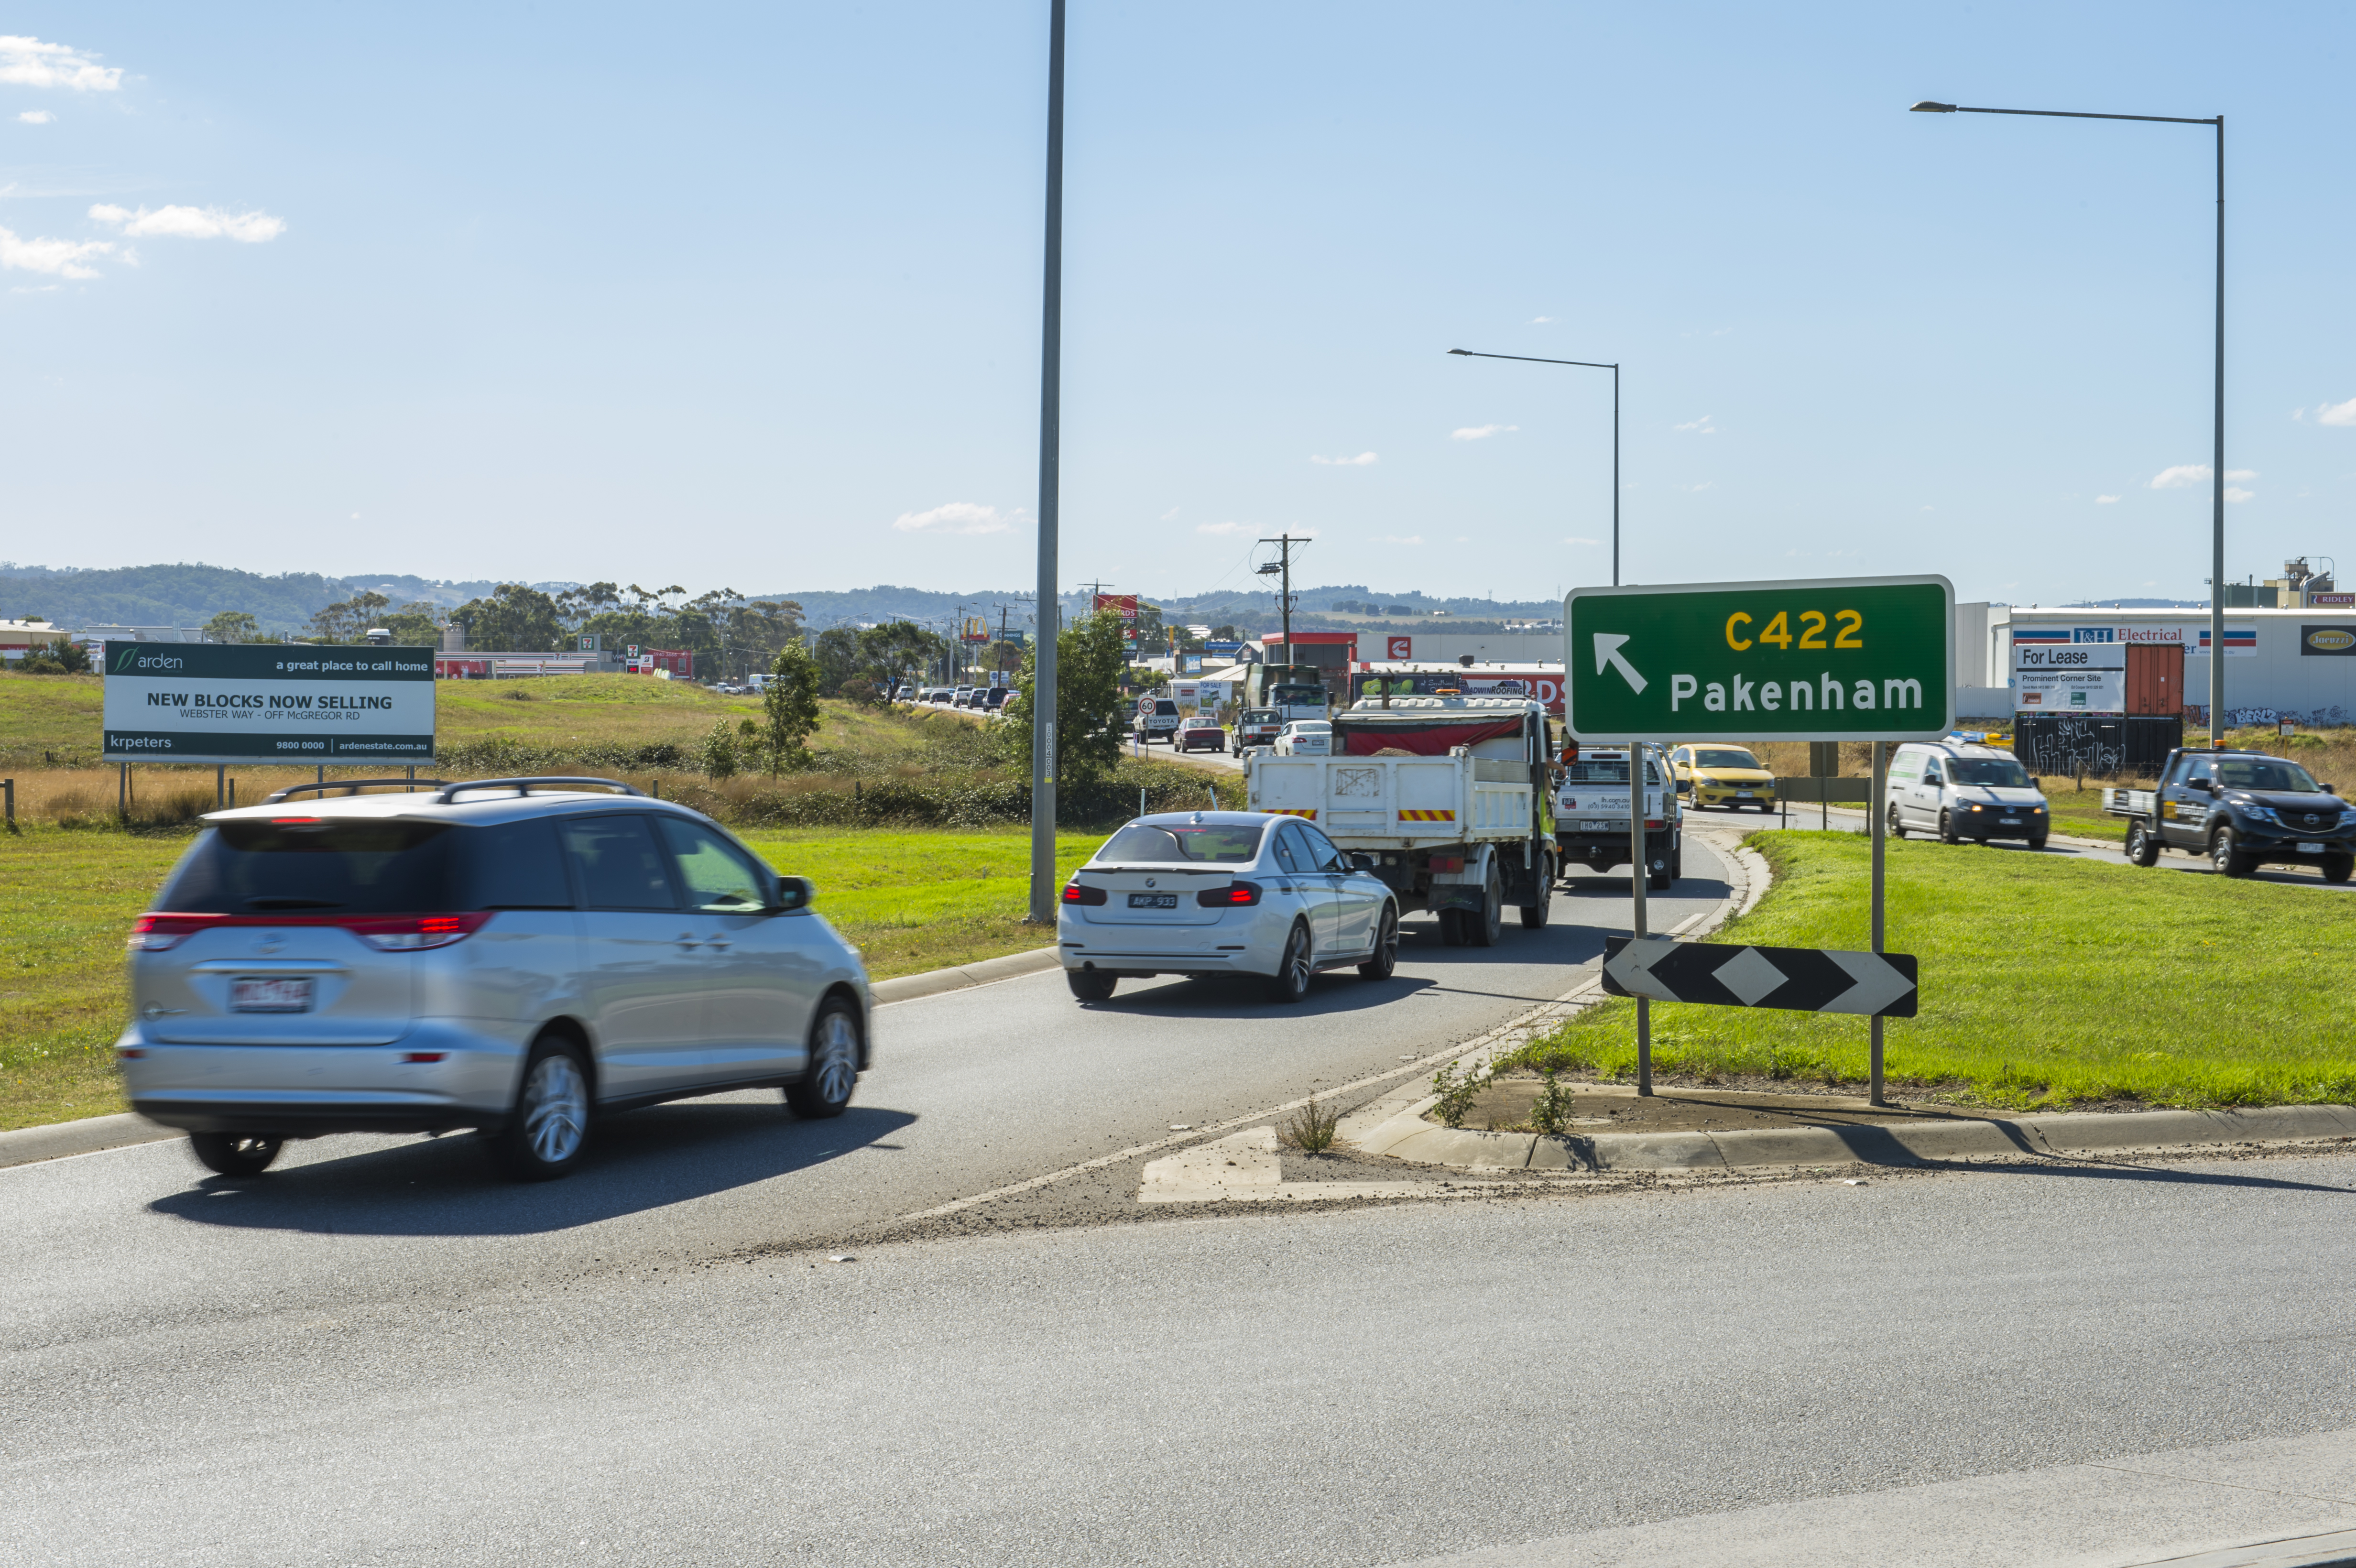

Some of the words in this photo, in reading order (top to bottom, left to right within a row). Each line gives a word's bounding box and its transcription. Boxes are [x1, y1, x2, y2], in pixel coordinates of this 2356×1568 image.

[1726, 610, 1863, 651] C422
[2118, 628, 2182, 641] Electrical
[2312, 635, 2349, 645] Jacuzzi
[138, 653, 183, 669] arden
[2023, 649, 2044, 664] For
[2049, 649, 2088, 664] Lease
[287, 661, 319, 672] great
[322, 661, 353, 672] place
[356, 662, 369, 670] to
[372, 661, 392, 671] call
[395, 661, 428, 671] home
[1671, 671, 1922, 712] Pakenham
[148, 693, 189, 707] NEW
[195, 694, 263, 708] BLOCKS
[269, 696, 313, 708] NOW
[318, 696, 392, 709] SELLING
[180, 709, 228, 718] WEBSTER
[232, 710, 254, 719] WAY
[264, 710, 284, 719] OFF
[287, 711, 342, 720] McGREGOR
[346, 711, 360, 720] RD
[111, 735, 172, 750] krpeters
